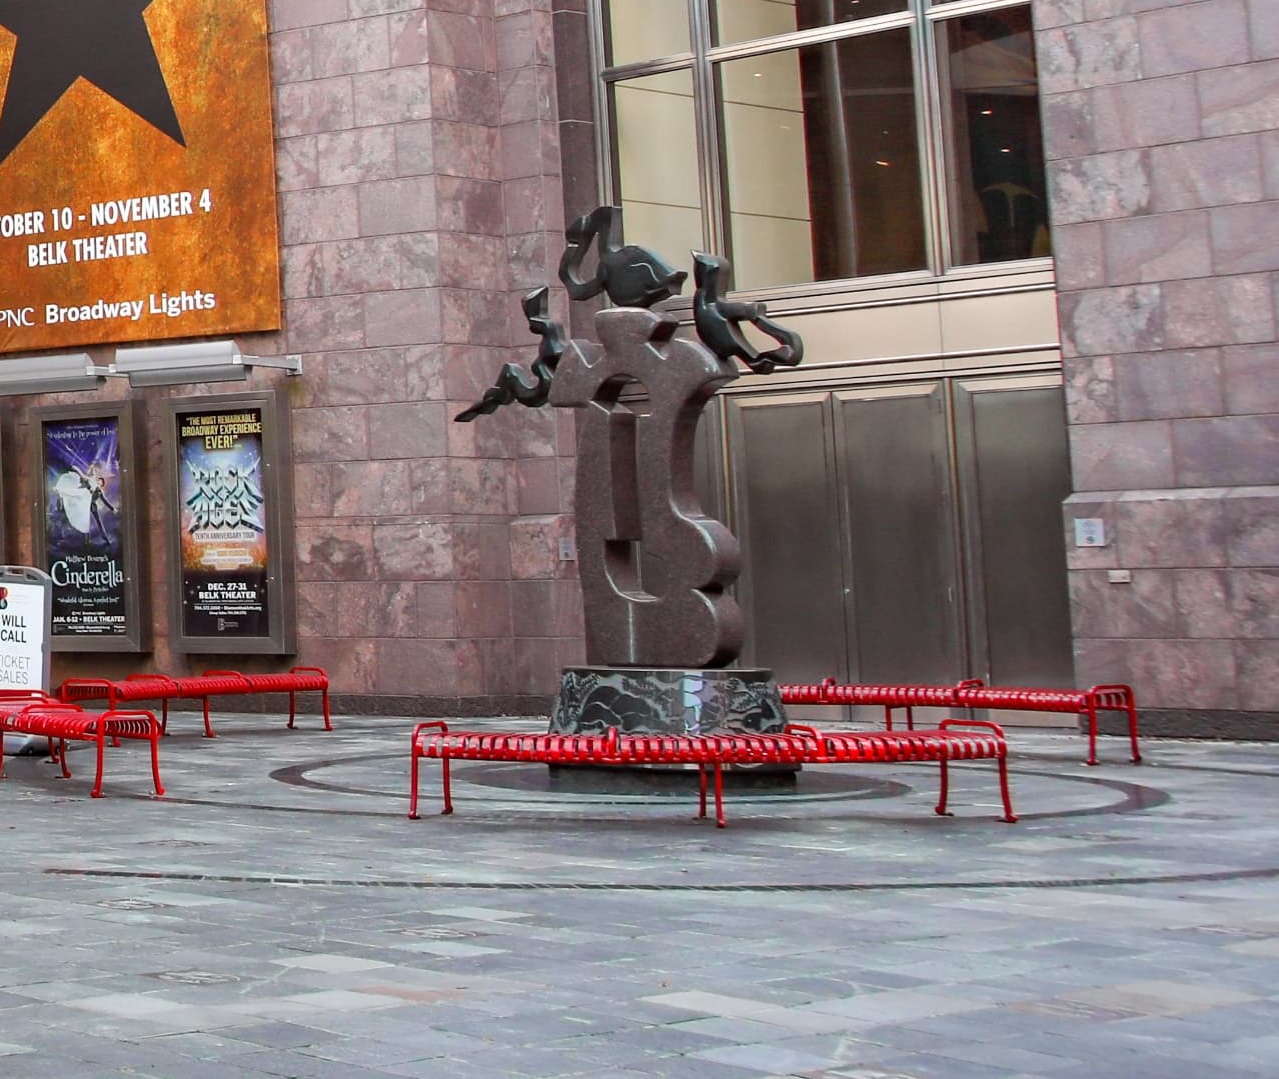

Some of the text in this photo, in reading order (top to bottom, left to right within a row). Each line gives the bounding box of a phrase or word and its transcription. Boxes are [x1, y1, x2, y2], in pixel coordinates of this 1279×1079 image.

[51, 208, 73, 232] 10
[90, 195, 191, 229] NOVEMBER
[198, 189, 211, 212] 4
[27, 232, 148, 269] BELK THEATER
[46, 299, 144, 325] Broadway
[149, 289, 216, 318] Lights
[201, 415, 217, 425] MOST
[217, 413, 257, 424] REMARKABLE
[182, 422, 262, 437] BROADWAY EXPERIENCE
[51, 560, 124, 589] Cinderella
[208, 582, 226, 591] DEC.
[198, 591, 257, 599] BELK THEATER
[1, 614, 27, 629] WILL
[0, 629, 27, 644] CALL
